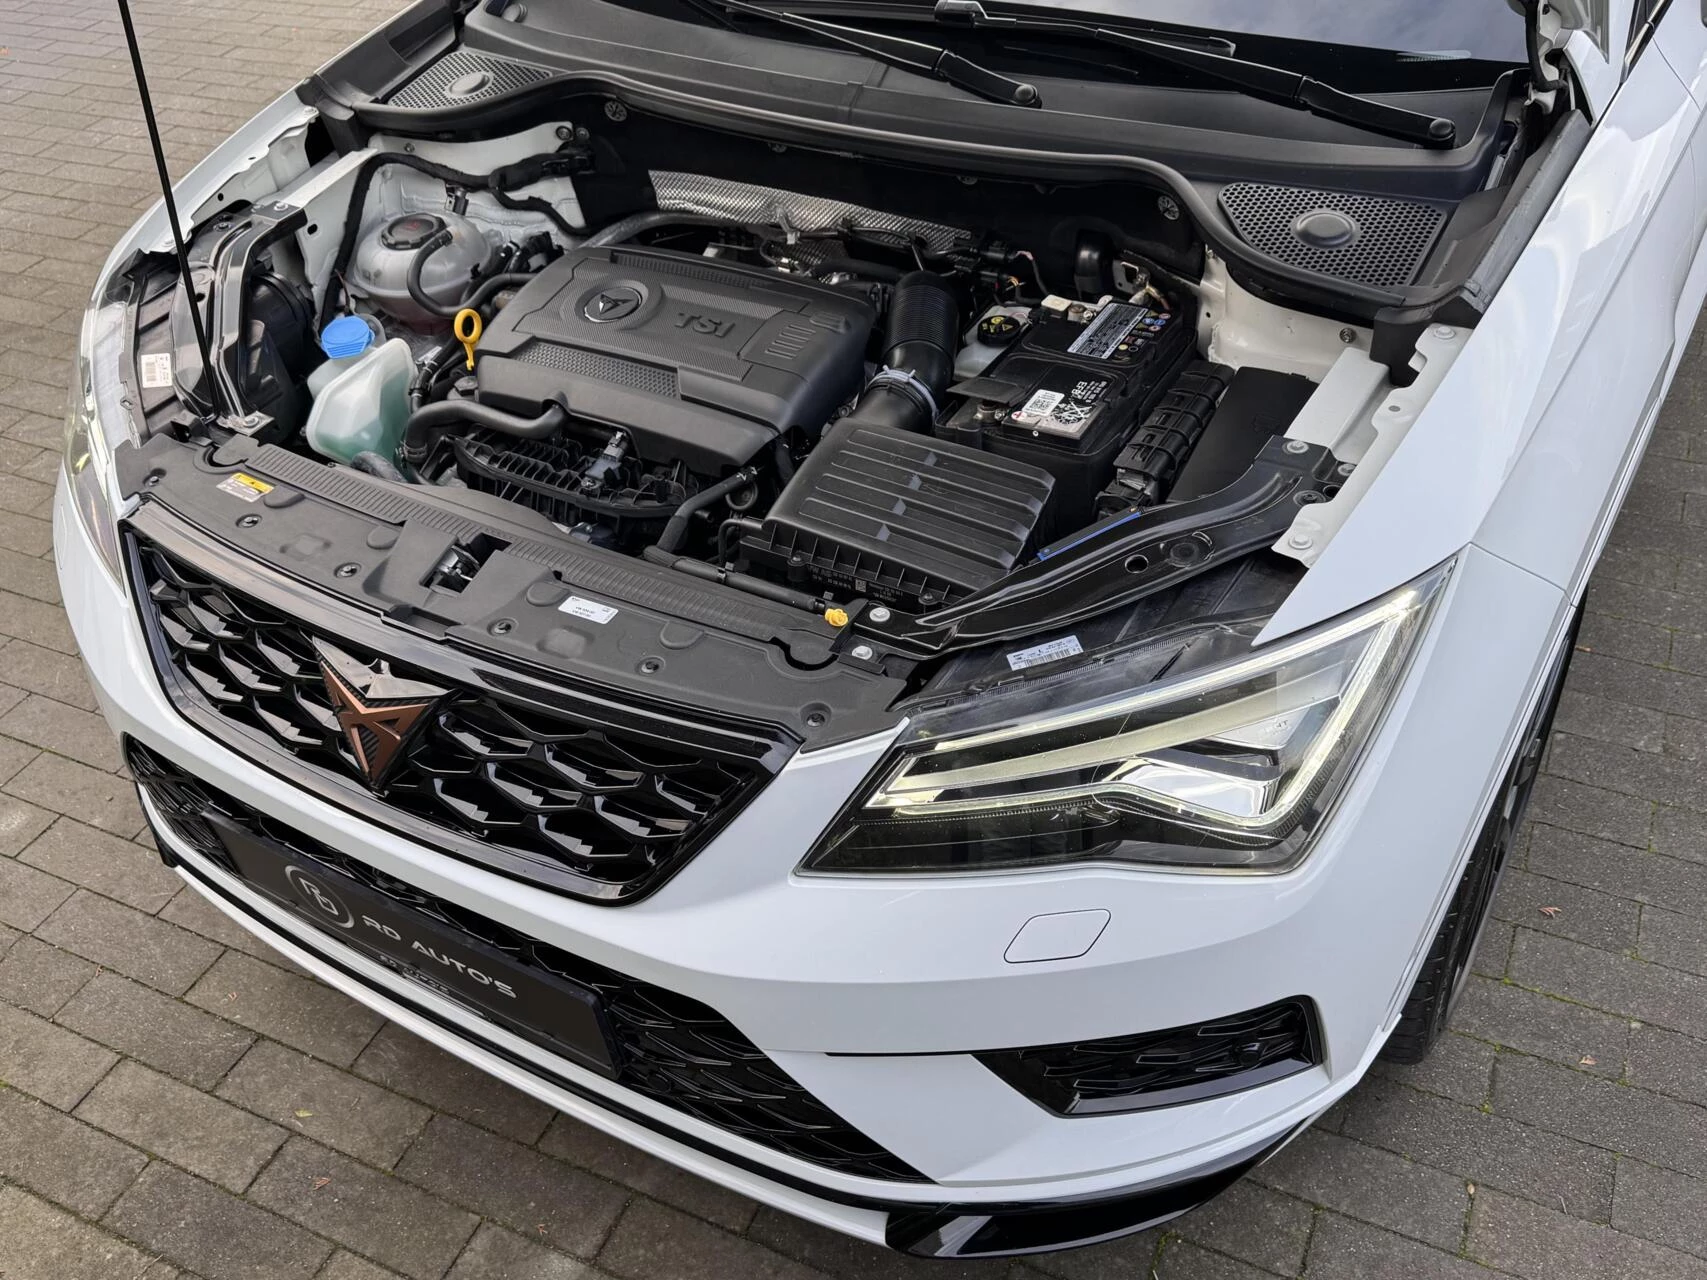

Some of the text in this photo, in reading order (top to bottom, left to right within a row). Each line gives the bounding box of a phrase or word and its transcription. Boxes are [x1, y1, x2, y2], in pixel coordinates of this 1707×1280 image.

[674, 312, 736, 338] TSI
[362, 915, 401, 941] RD
[411, 940, 517, 999] AUTO'S
